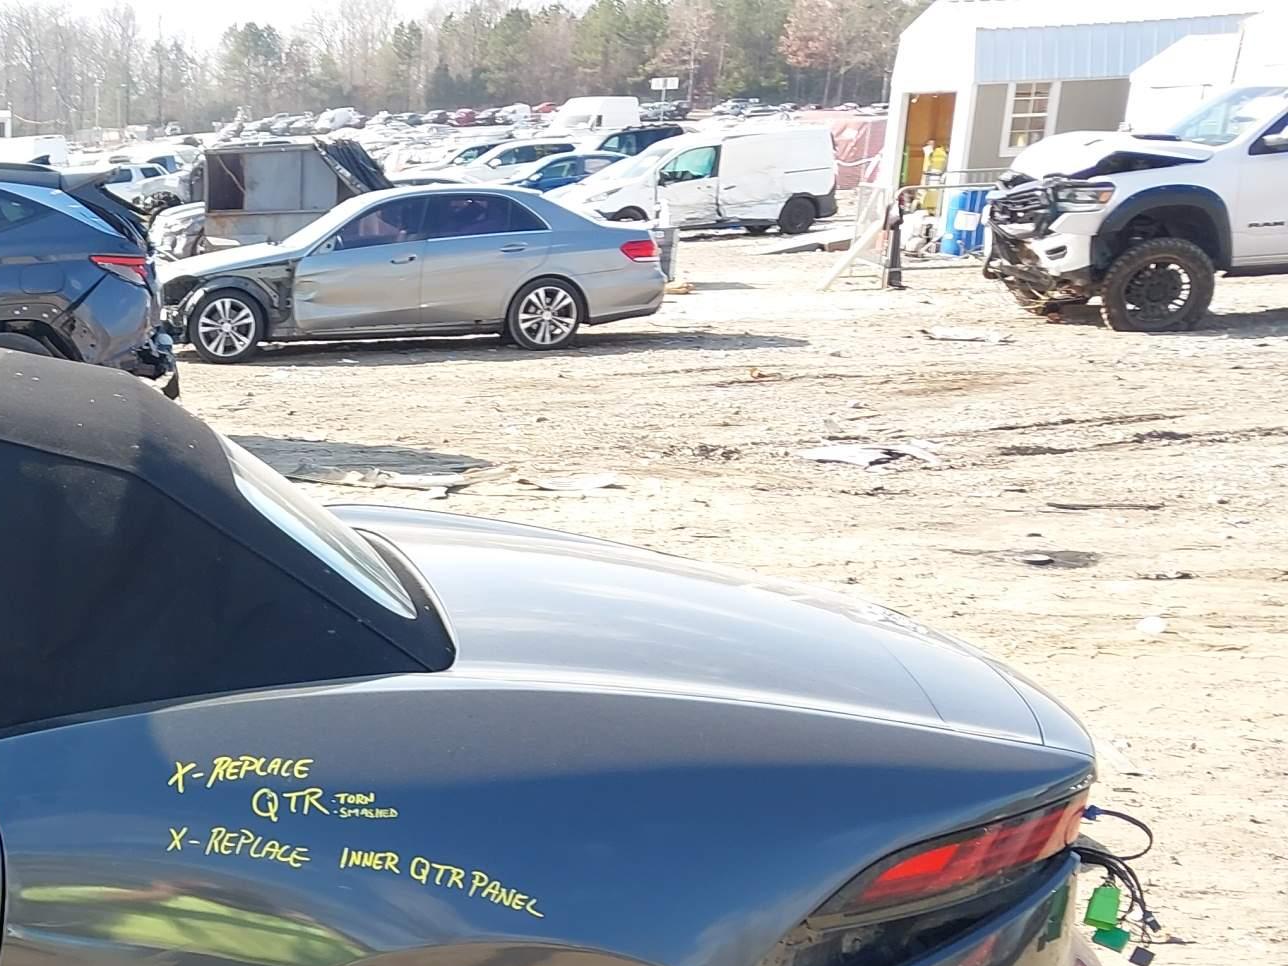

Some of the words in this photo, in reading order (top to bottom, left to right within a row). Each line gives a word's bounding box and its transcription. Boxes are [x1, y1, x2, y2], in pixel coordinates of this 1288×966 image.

[251, 787, 330, 822] QTR
[339, 847, 401, 874] INNER
[409, 857, 464, 890] QTR
[470, 872, 545, 918] PANEL
